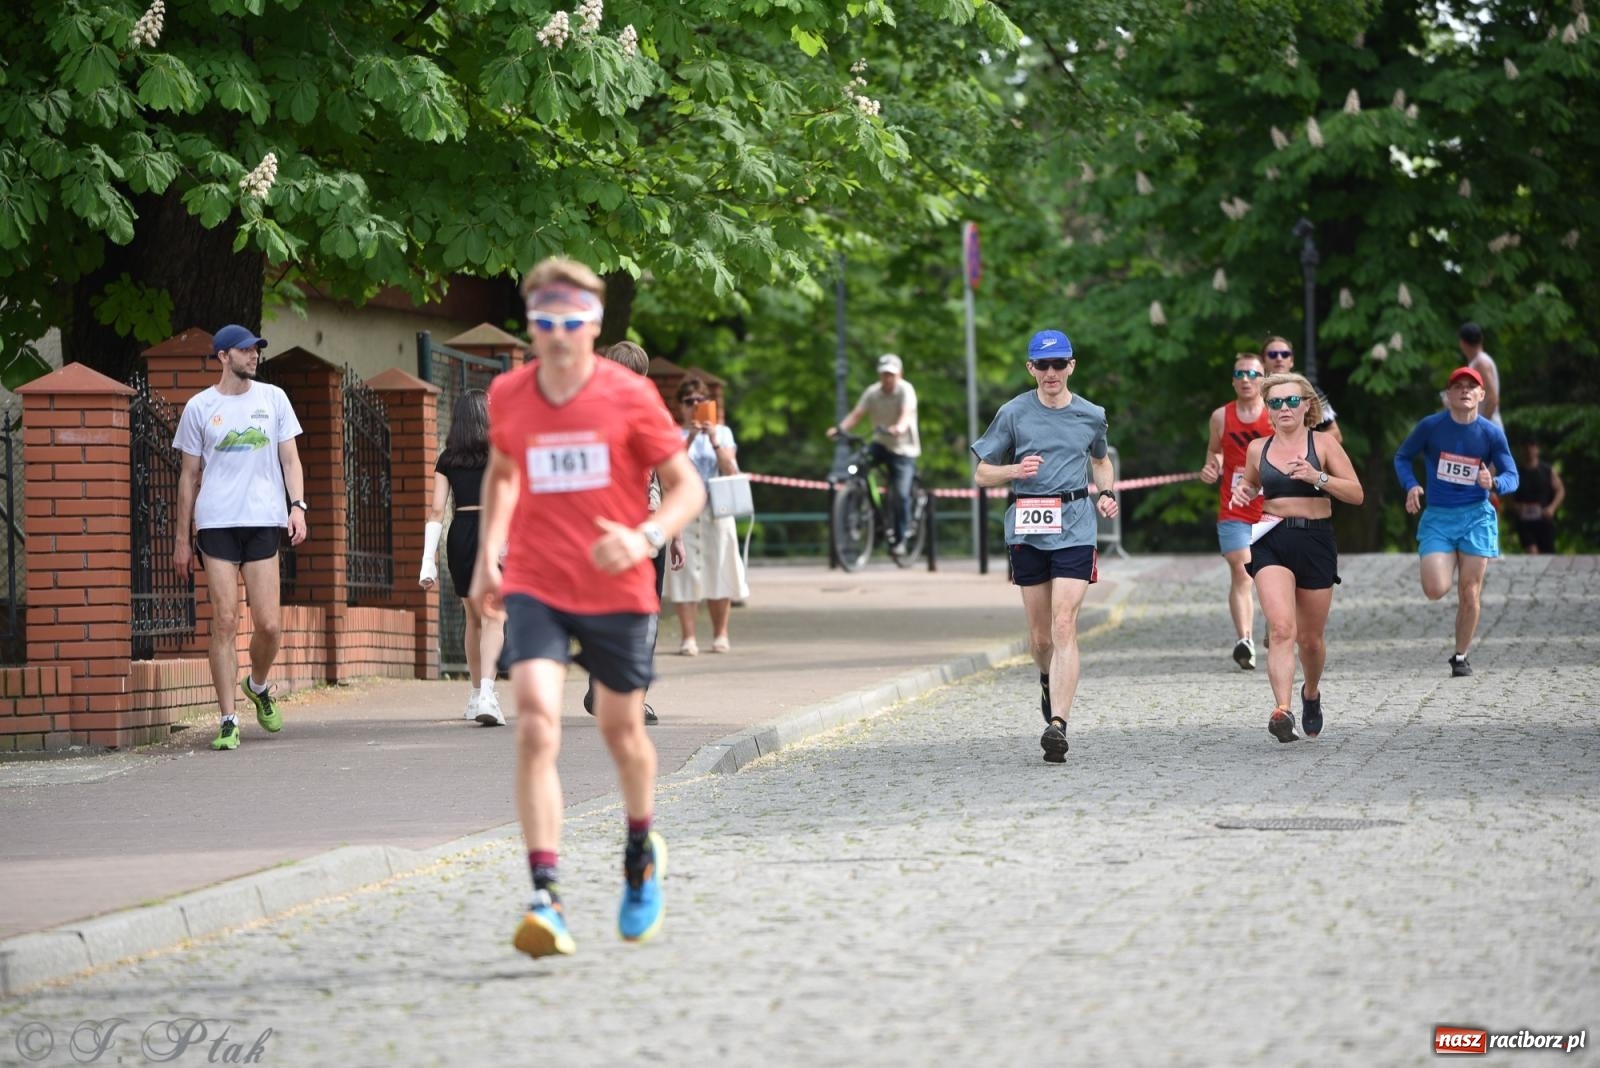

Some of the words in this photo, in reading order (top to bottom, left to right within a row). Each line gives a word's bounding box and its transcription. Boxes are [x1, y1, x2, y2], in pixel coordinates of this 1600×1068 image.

[550, 451, 588, 472] 161
[1446, 462, 1472, 477] 155
[1022, 510, 1054, 524] 206
